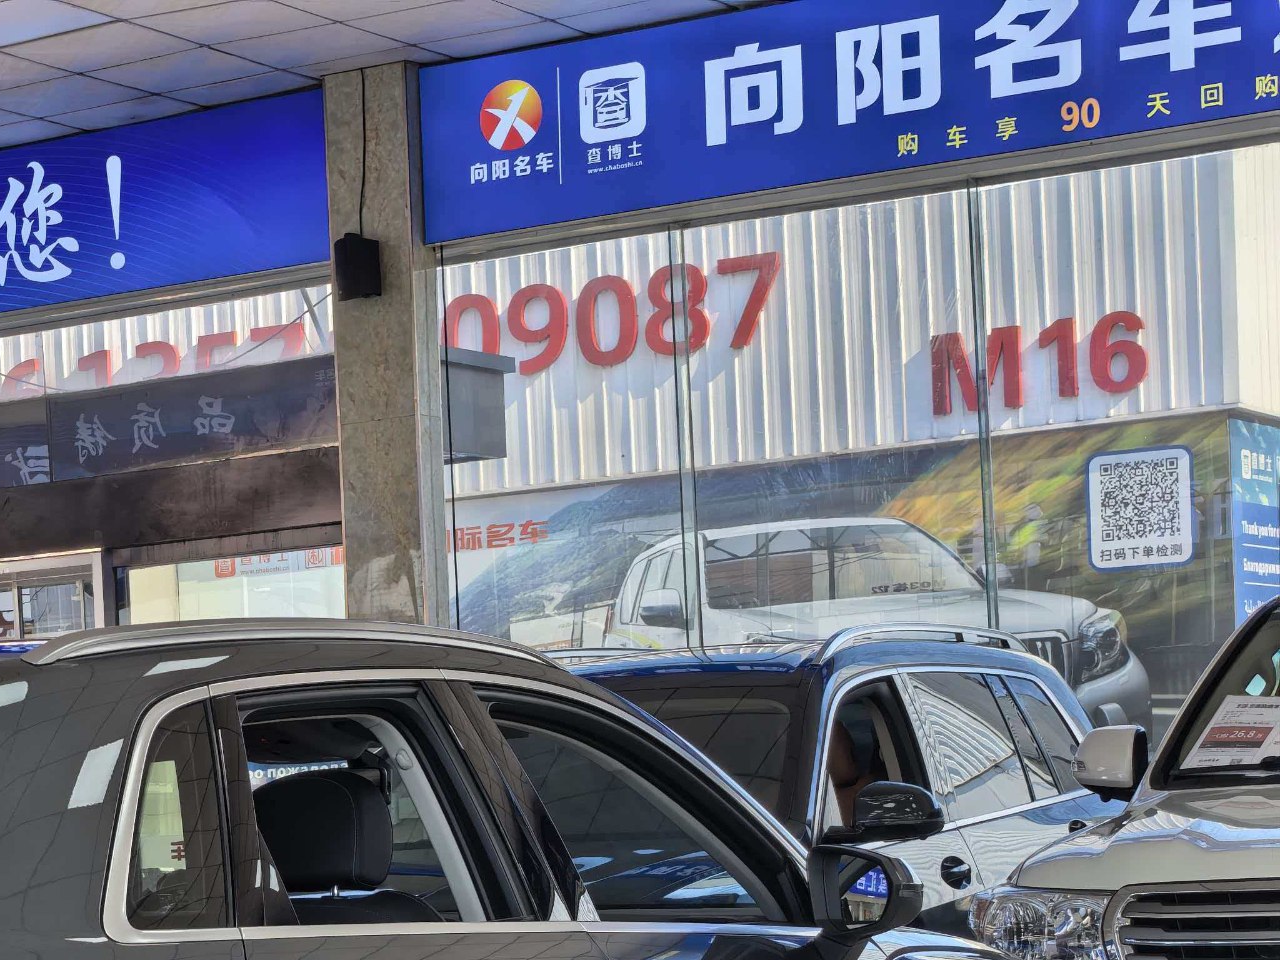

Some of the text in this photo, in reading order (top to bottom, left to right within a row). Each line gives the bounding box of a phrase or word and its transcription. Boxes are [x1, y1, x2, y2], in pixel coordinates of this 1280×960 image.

[704, 0, 1280, 147] 向阳名车
[897, 73, 1279, 157] 购车享 90 天回购
[470, 152, 554, 184] 向阳名车
[587, 141, 642, 164] 查博士
[931, 310, 1150, 416] M16
[446, 519, 549, 553] 际名车
[1100, 543, 1183, 562] 扫码下单检测
